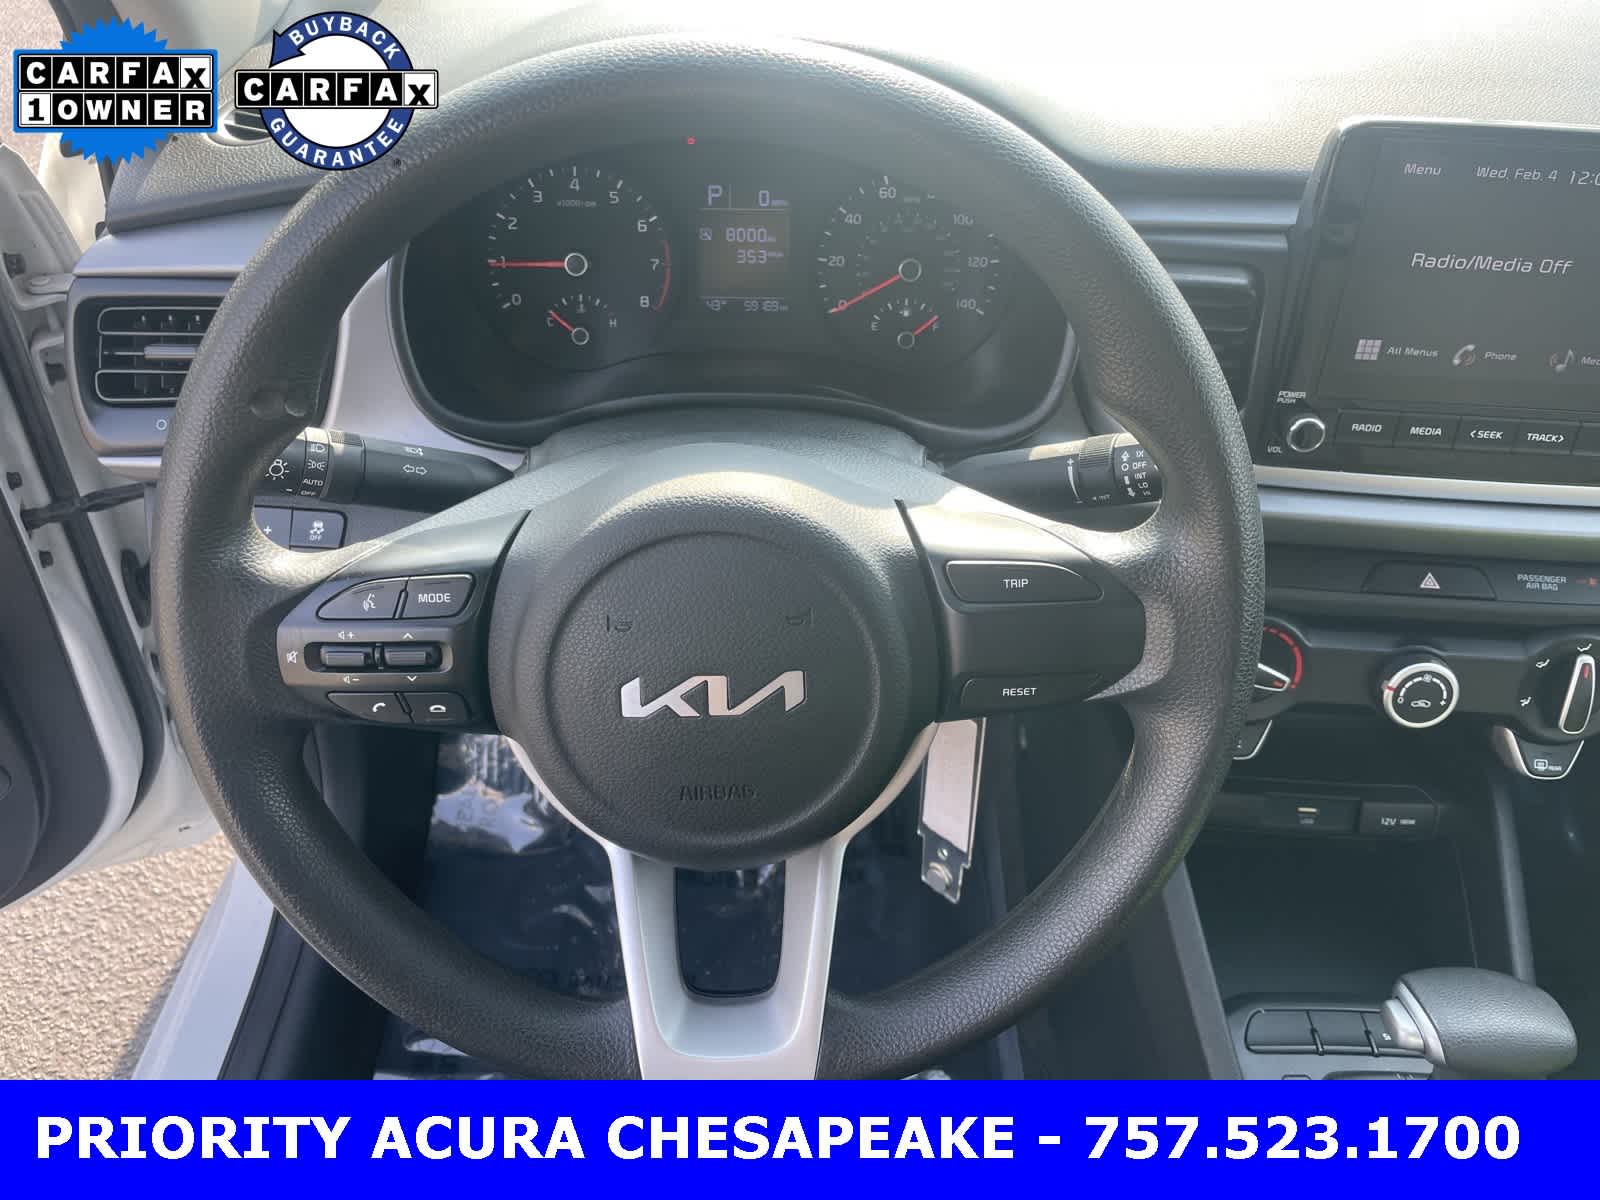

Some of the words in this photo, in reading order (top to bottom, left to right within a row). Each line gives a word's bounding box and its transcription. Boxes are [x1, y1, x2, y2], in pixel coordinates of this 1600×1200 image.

[1404, 163, 1441, 177] Menu
[569, 178, 580, 191] 4
[533, 191, 543, 203] 3
[609, 191, 620, 204] 5
[708, 185, 722, 206] P
[879, 187, 896, 199] 60
[507, 217, 518, 230] 2
[844, 214, 862, 225] 40
[637, 219, 648, 232] 6
[650, 259, 660, 271] 7
[827, 255, 846, 267] 20
[1411, 252, 1533, 274] Radio/Media
[1539, 259, 1574, 275] Off
[511, 293, 521, 306] 0
[639, 295, 650, 308] 8
[1405, 347, 1439, 358] Menus
[1484, 351, 1518, 362] Phone
[1278, 391, 1306, 399] POWER
[1351, 424, 1382, 433] RADIO
[1410, 426, 1442, 437] MEDIA
[1267, 446, 1283, 454] VOL
[1132, 461, 1147, 470] OFF
[1134, 472, 1147, 480] INT
[303, 478, 324, 487] AUTO
[1137, 481, 1149, 489] LO
[309, 534, 323, 542] OFF
[1004, 578, 1029, 589] TRIP
[1516, 573, 1567, 584] PASSENGER
[1526, 582, 1540, 590] AIR
[1541, 583, 1559, 592] BAG
[418, 593, 451, 605] MODE
[1002, 687, 1037, 697] RESET
[680, 784, 756, 801] AIRBAG
